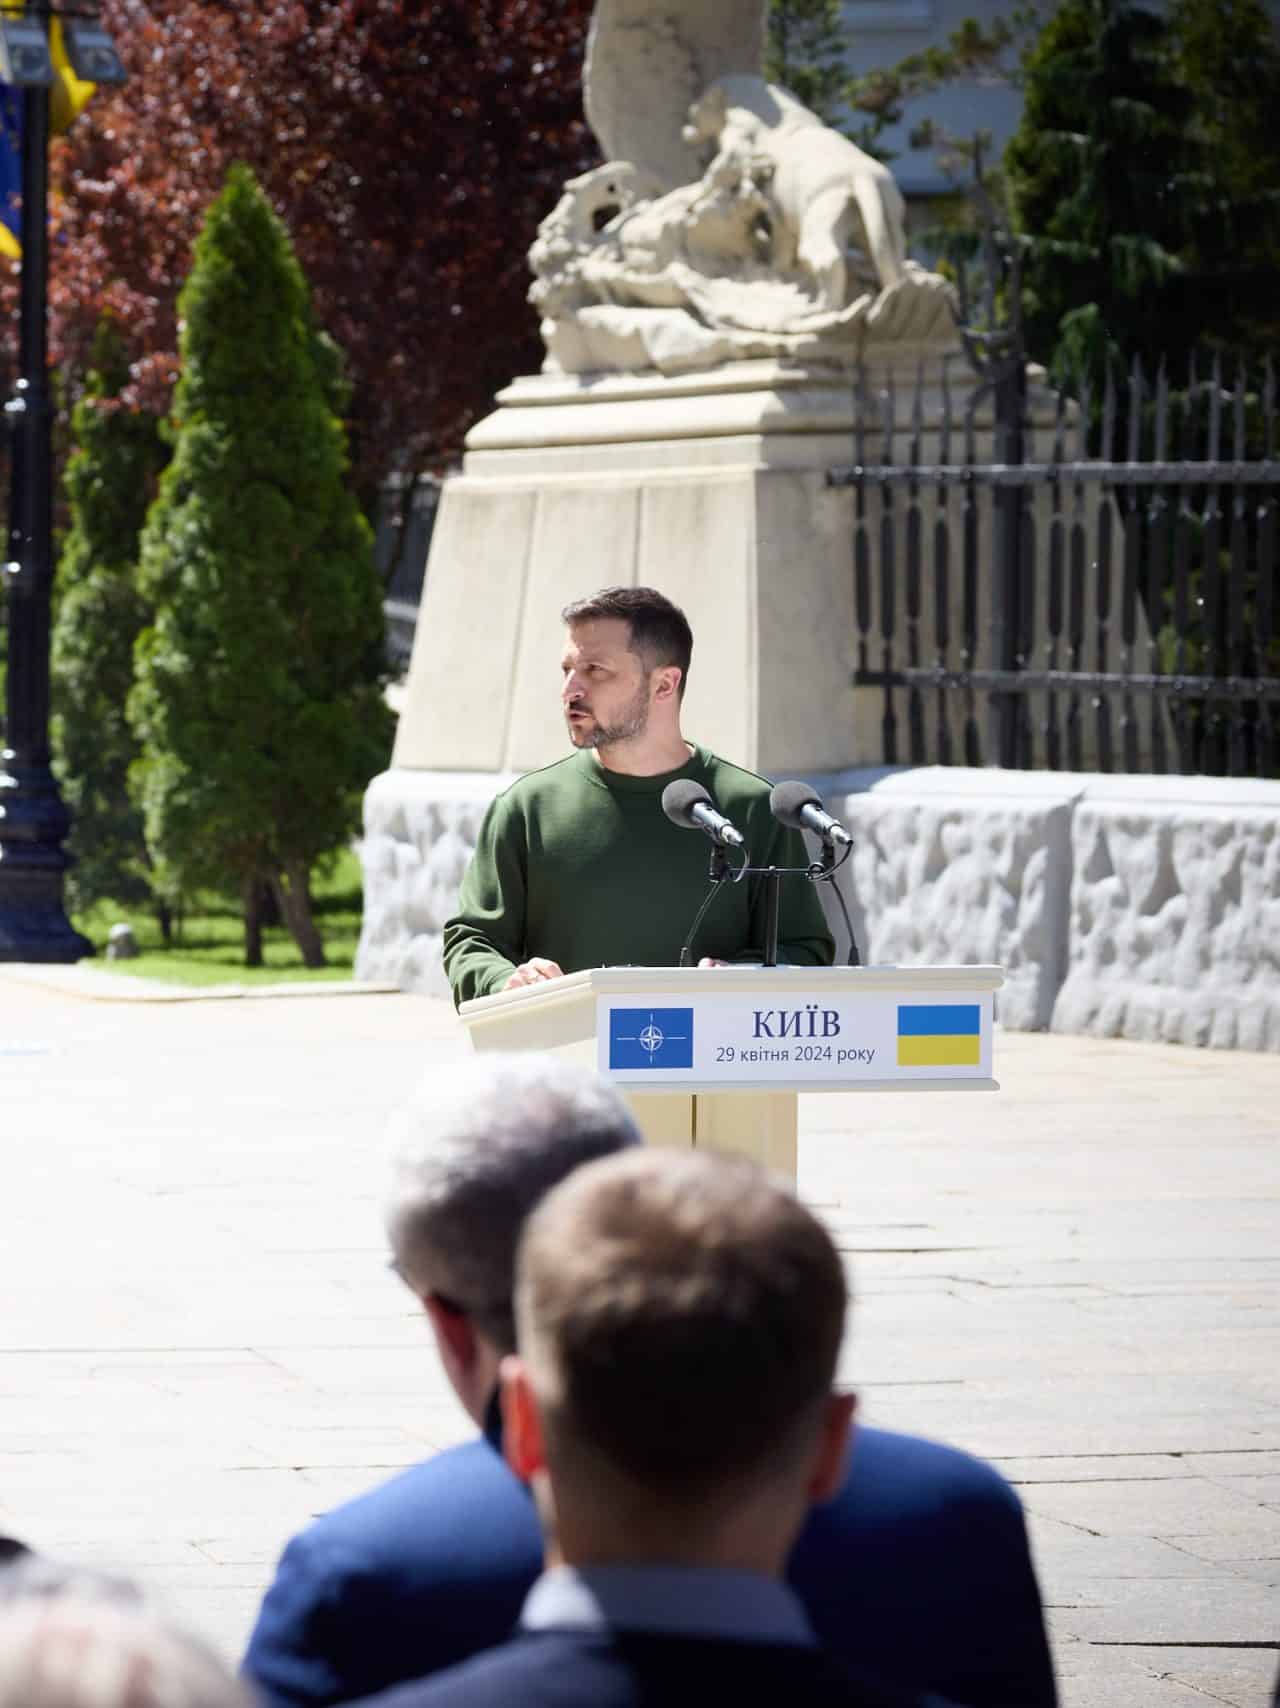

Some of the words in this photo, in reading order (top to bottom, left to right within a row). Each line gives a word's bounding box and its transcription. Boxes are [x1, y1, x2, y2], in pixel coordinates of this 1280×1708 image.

[751, 1003, 841, 1038] КИЇВ
[715, 1046, 735, 1062] 29
[740, 1046, 789, 1062] квітня
[794, 1045, 833, 1061] 2024
[837, 1048, 876, 1065] року
